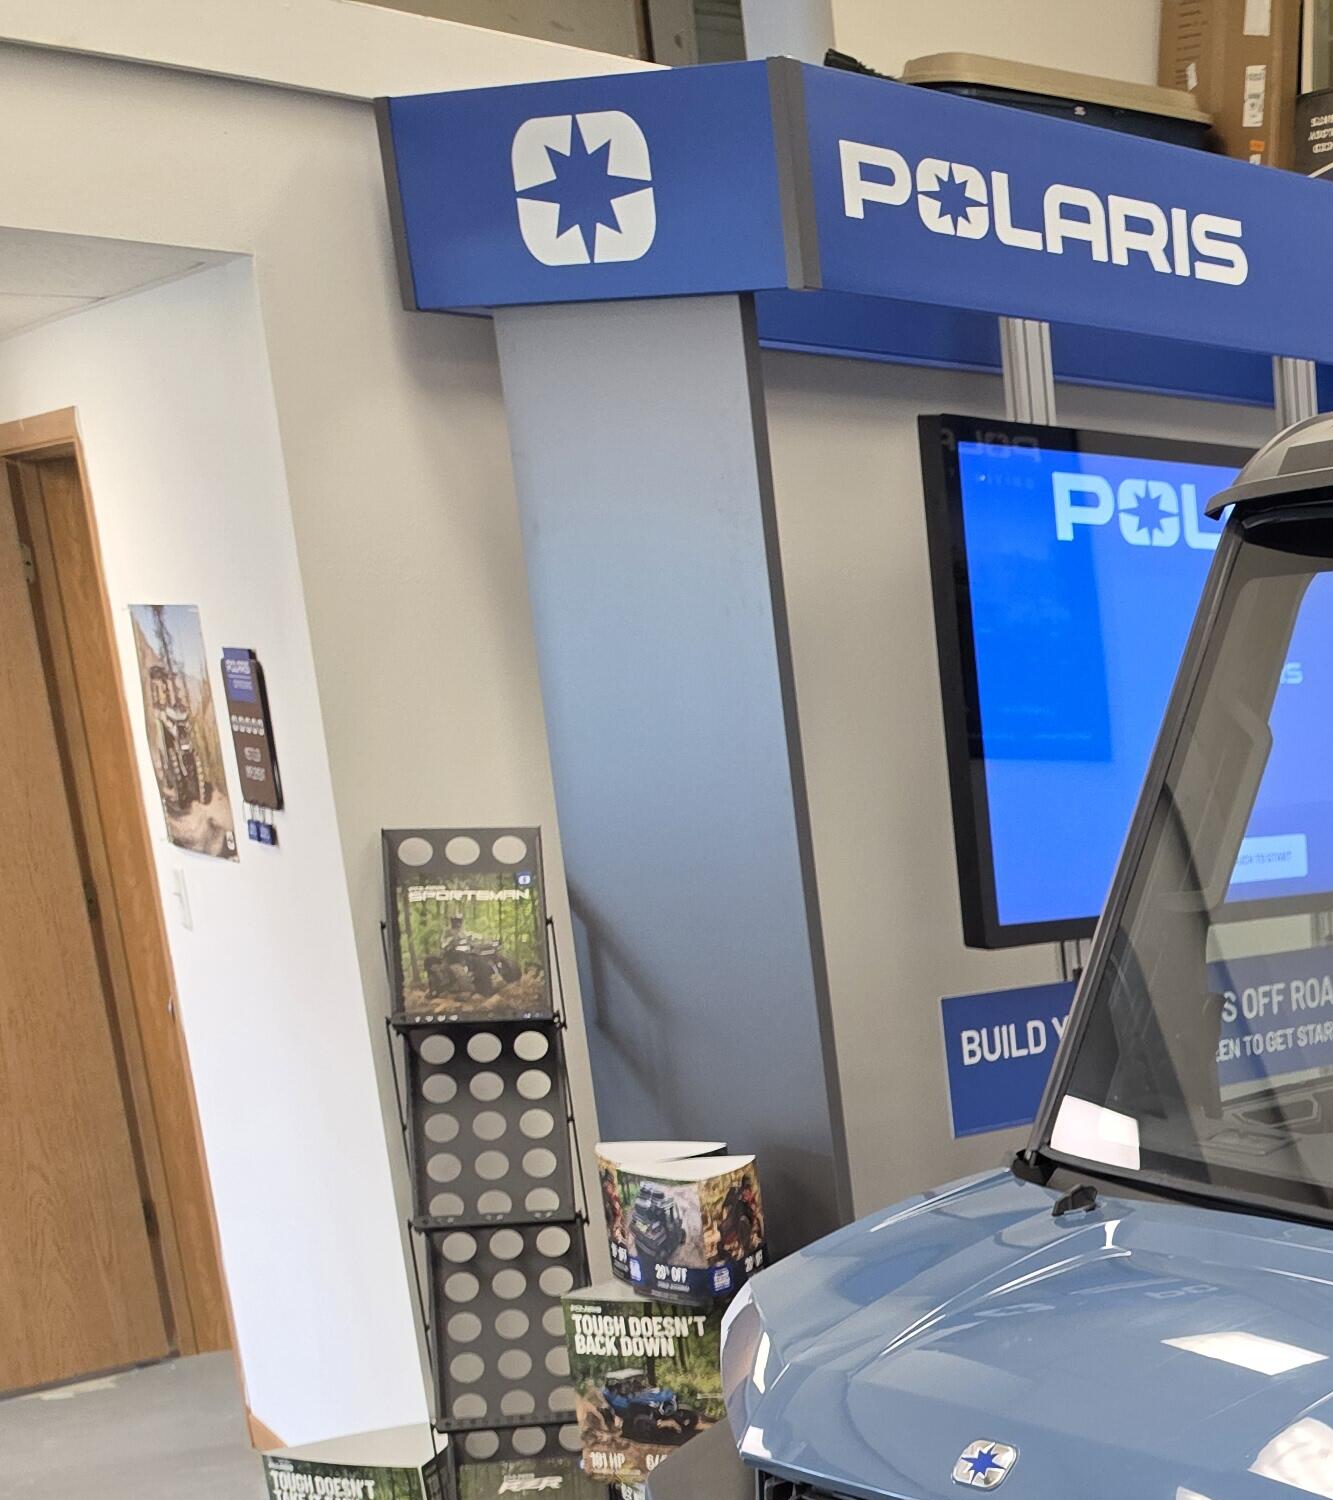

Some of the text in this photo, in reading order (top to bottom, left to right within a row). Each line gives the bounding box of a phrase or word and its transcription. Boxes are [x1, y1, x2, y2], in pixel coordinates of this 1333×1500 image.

[838, 139, 1249, 286] POLARIS
[1242, 983, 1286, 1019] OFF
[961, 1019, 1047, 1066] BUILD
[1243, 1033, 1264, 1056] TO
[1266, 1027, 1295, 1053] GET
[571, 1314, 707, 1338] TOUGH DOESN'T
[575, 1334, 676, 1357] BACK DOWN
[270, 1471, 375, 1500] TOUGH DOESN'T
